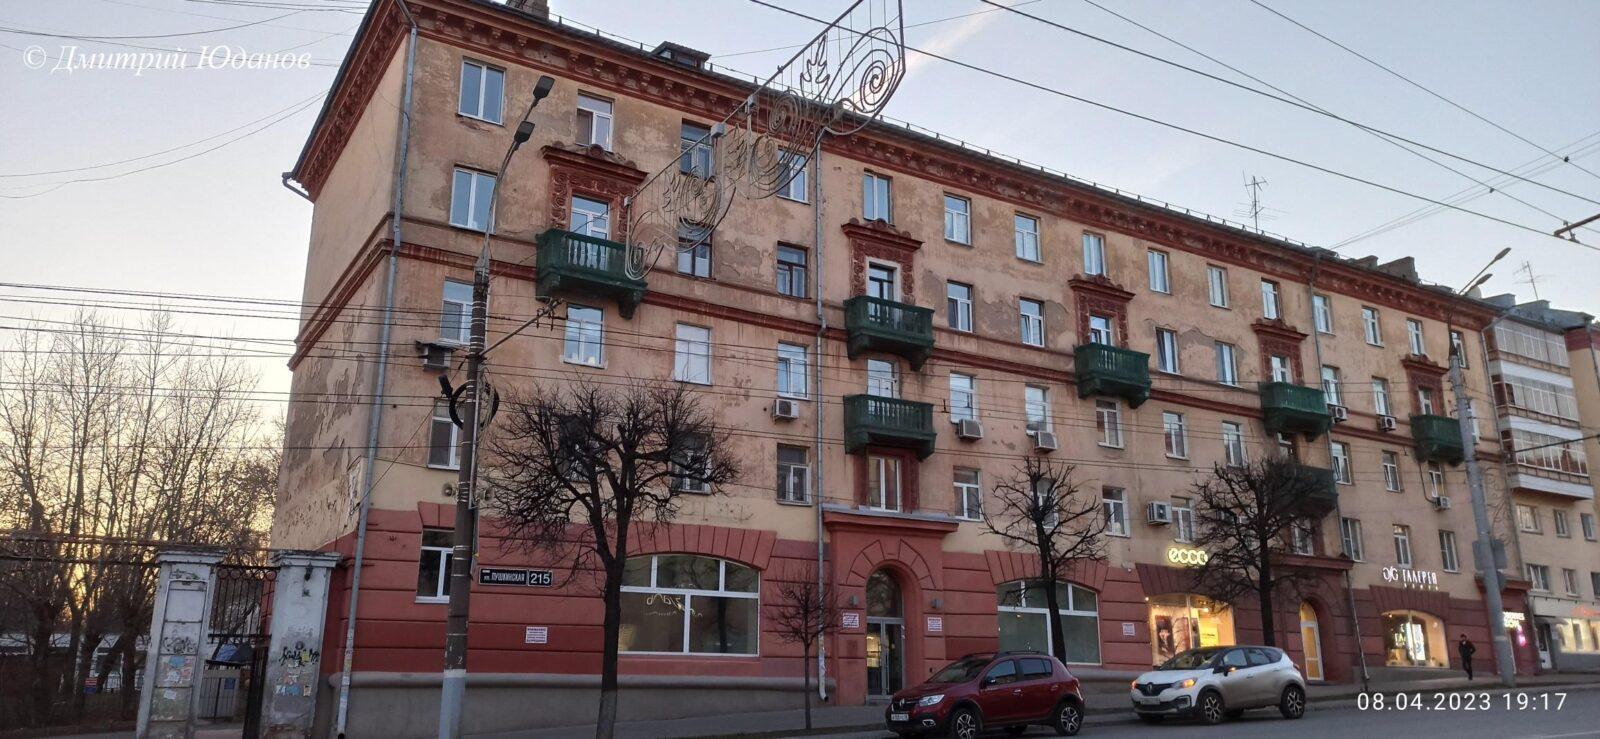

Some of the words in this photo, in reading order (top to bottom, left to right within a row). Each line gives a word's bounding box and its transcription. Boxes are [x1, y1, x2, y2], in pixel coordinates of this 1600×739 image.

[1168, 547, 1209, 566] ecco
[491, 572, 525, 582] ПУШКИНСКАЯ
[530, 573, 551, 585] 215
